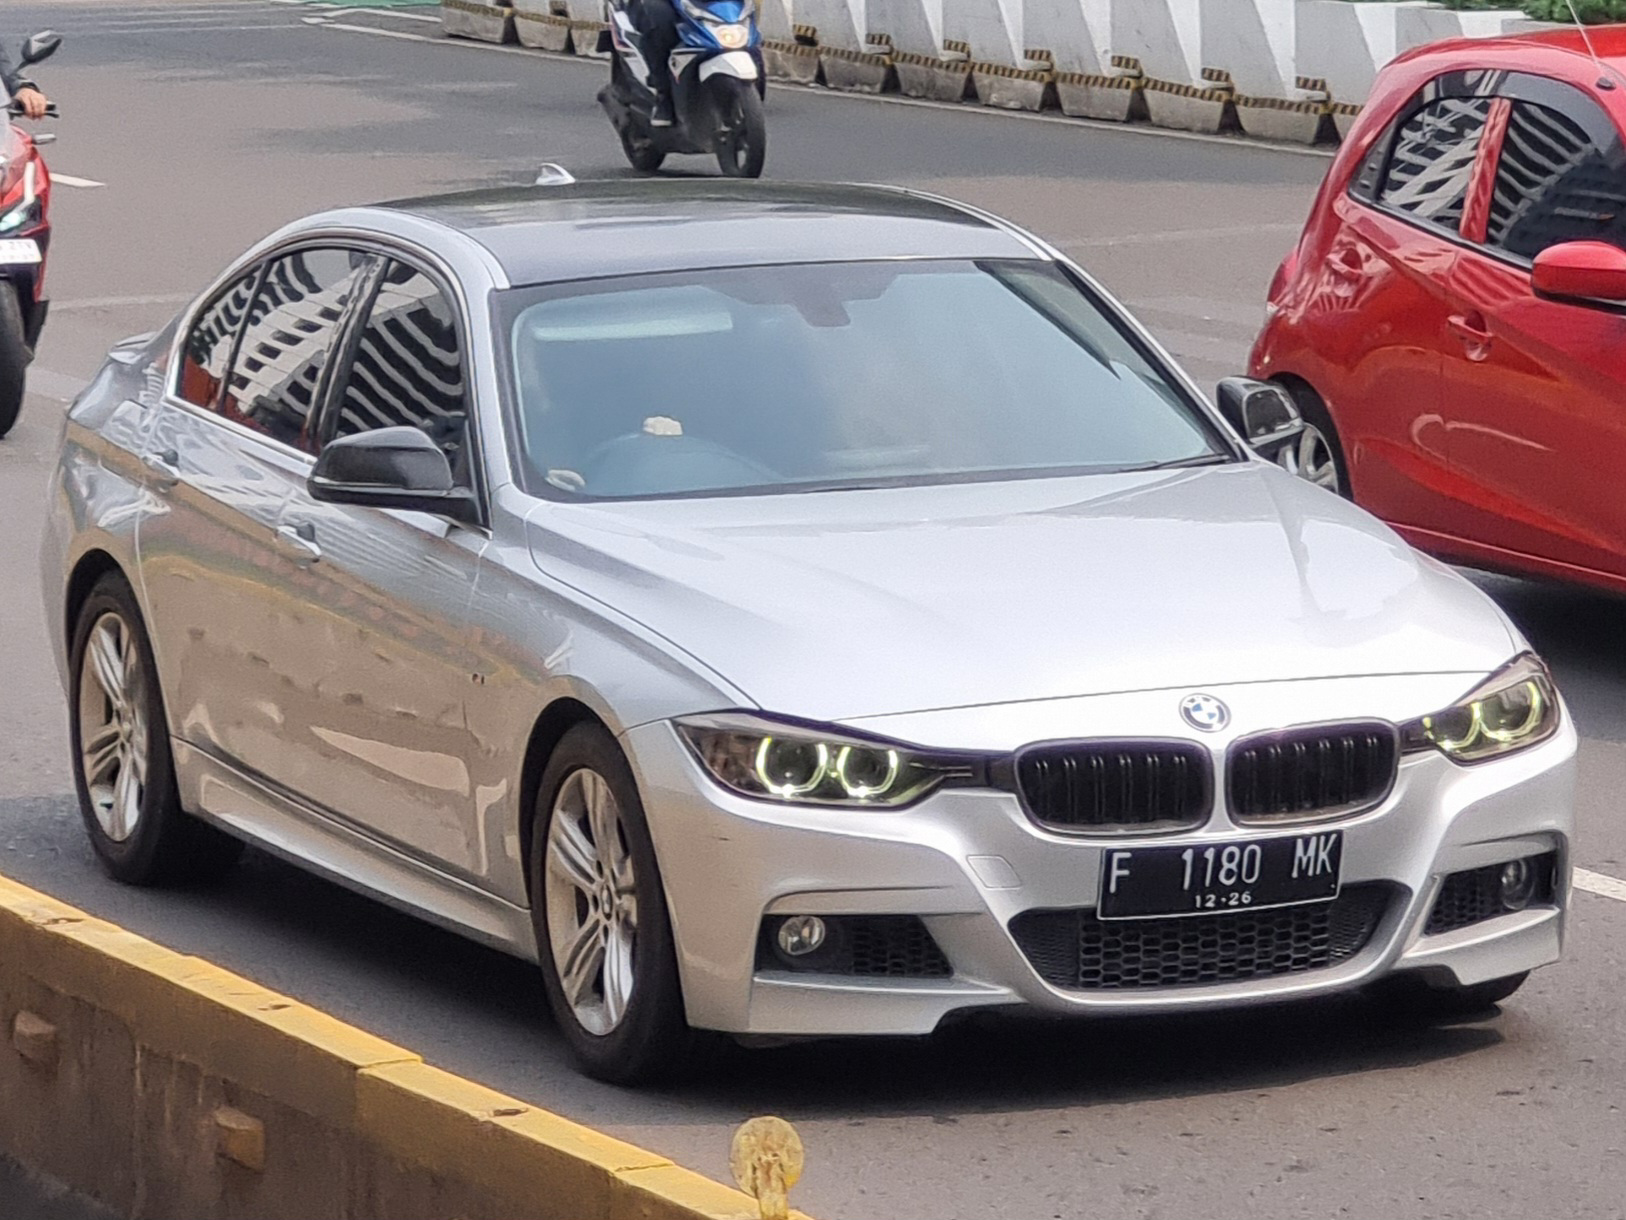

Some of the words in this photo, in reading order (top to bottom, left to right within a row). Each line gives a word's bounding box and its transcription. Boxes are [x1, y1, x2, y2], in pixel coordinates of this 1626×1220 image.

[1109, 852, 1132, 893] F
[1181, 844, 1262, 891] 1180
[1291, 833, 1338, 879] MK
